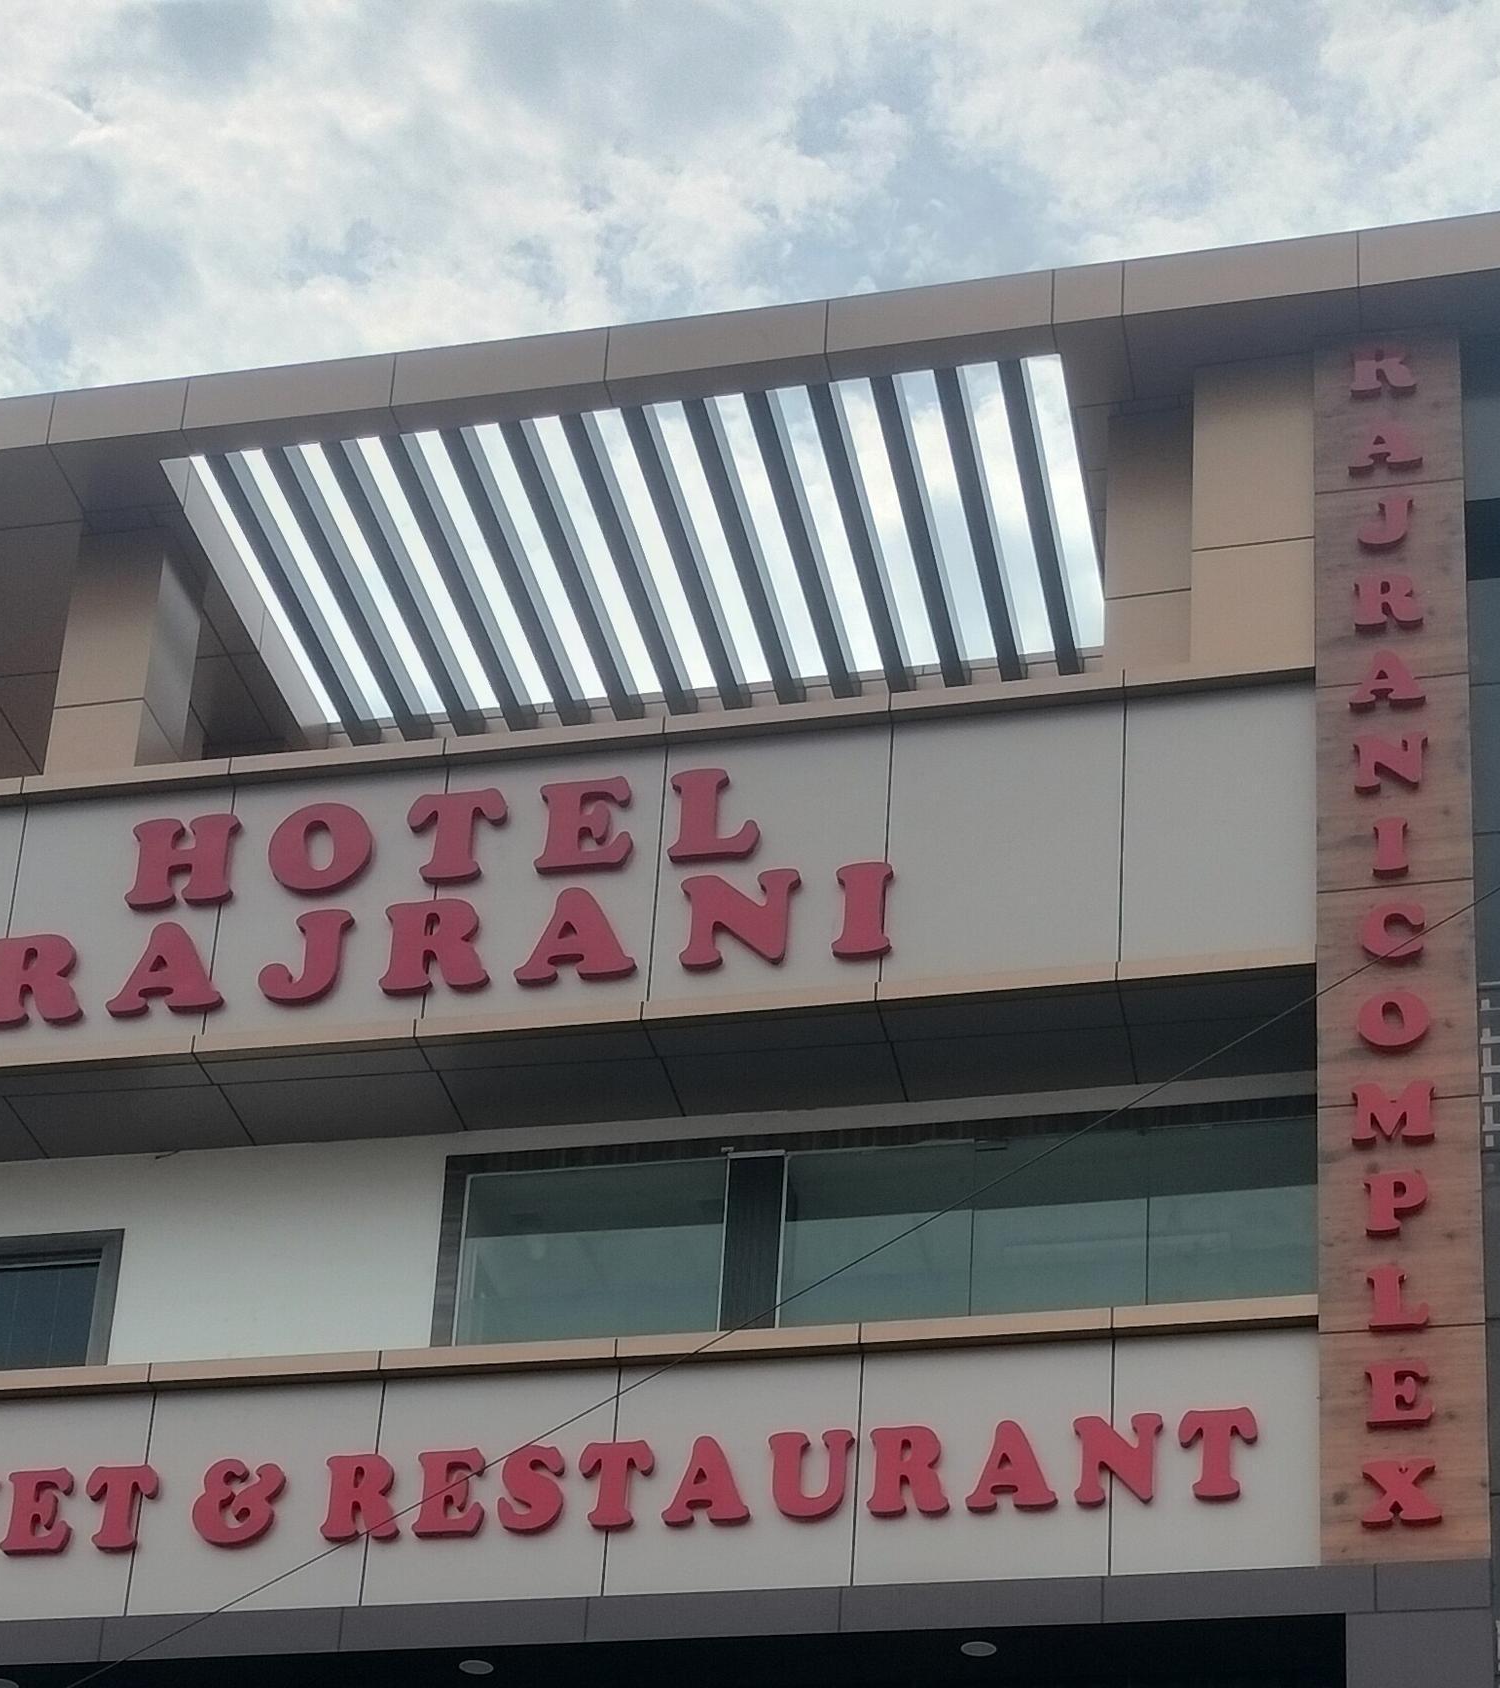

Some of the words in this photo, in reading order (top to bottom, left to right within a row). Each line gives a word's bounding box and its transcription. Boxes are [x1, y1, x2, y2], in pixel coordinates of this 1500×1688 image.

[125, 768, 760, 912] HOTEL
[192, 1458, 285, 1548] &
[319, 1406, 1258, 1542] RESTAURANT
